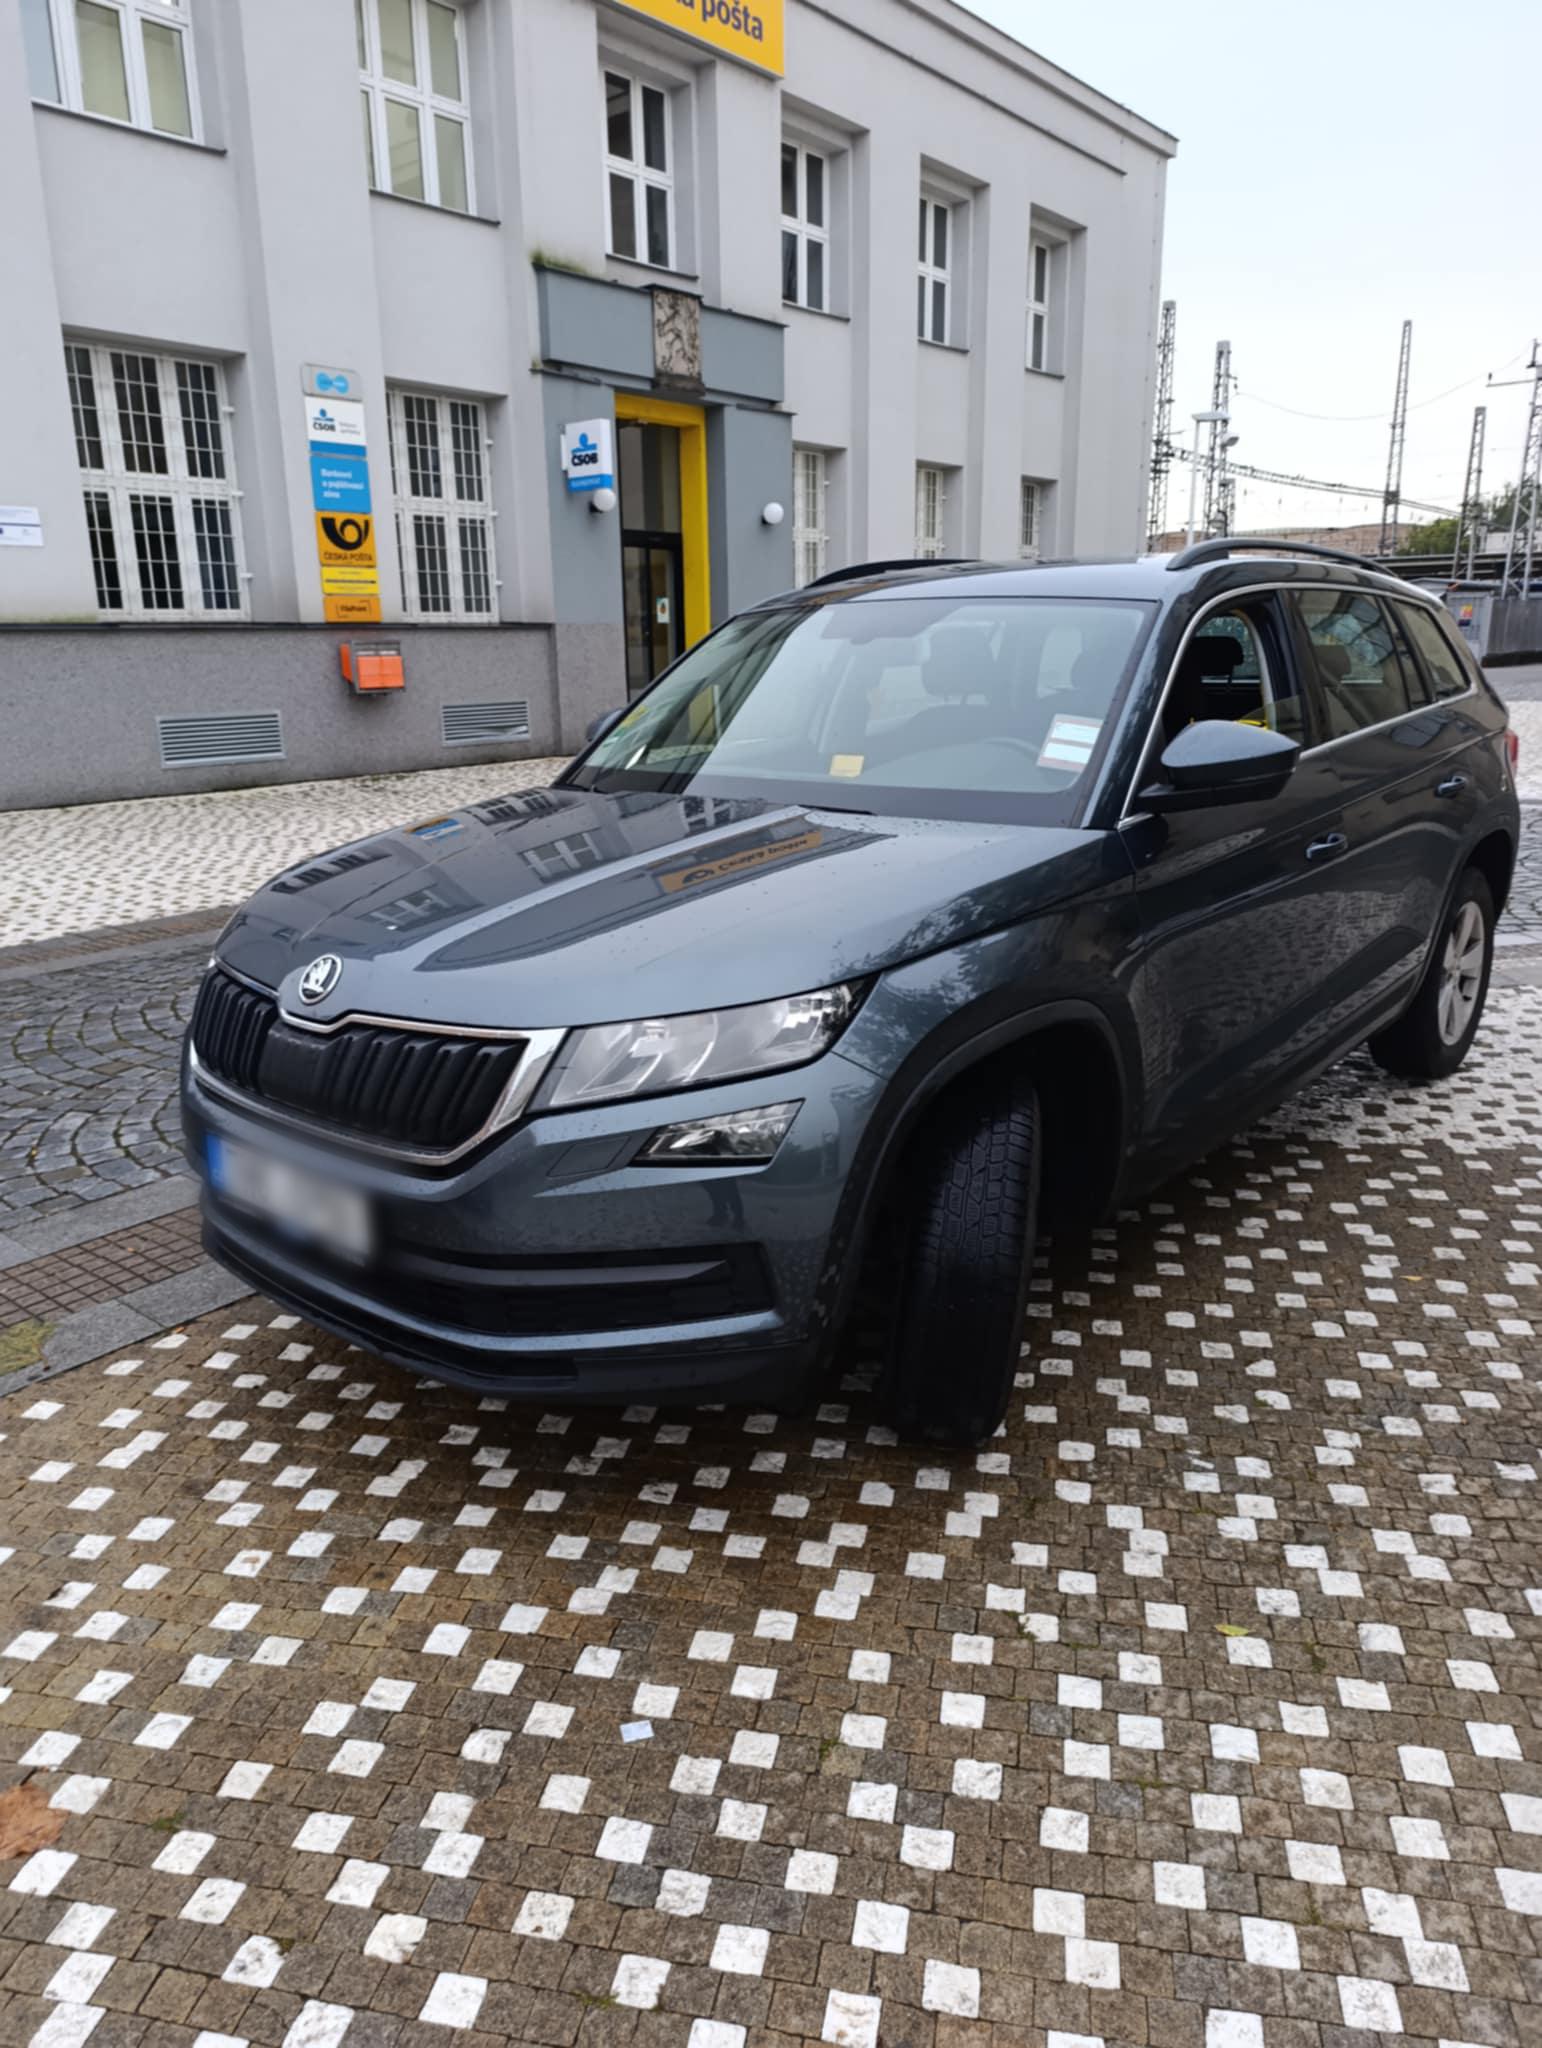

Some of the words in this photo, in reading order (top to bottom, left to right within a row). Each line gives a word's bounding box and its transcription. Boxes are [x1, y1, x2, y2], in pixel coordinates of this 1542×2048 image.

[702, 0, 763, 42] pošta
[312, 420, 336, 432] ČSOB
[571, 451, 598, 467] ČSOB
